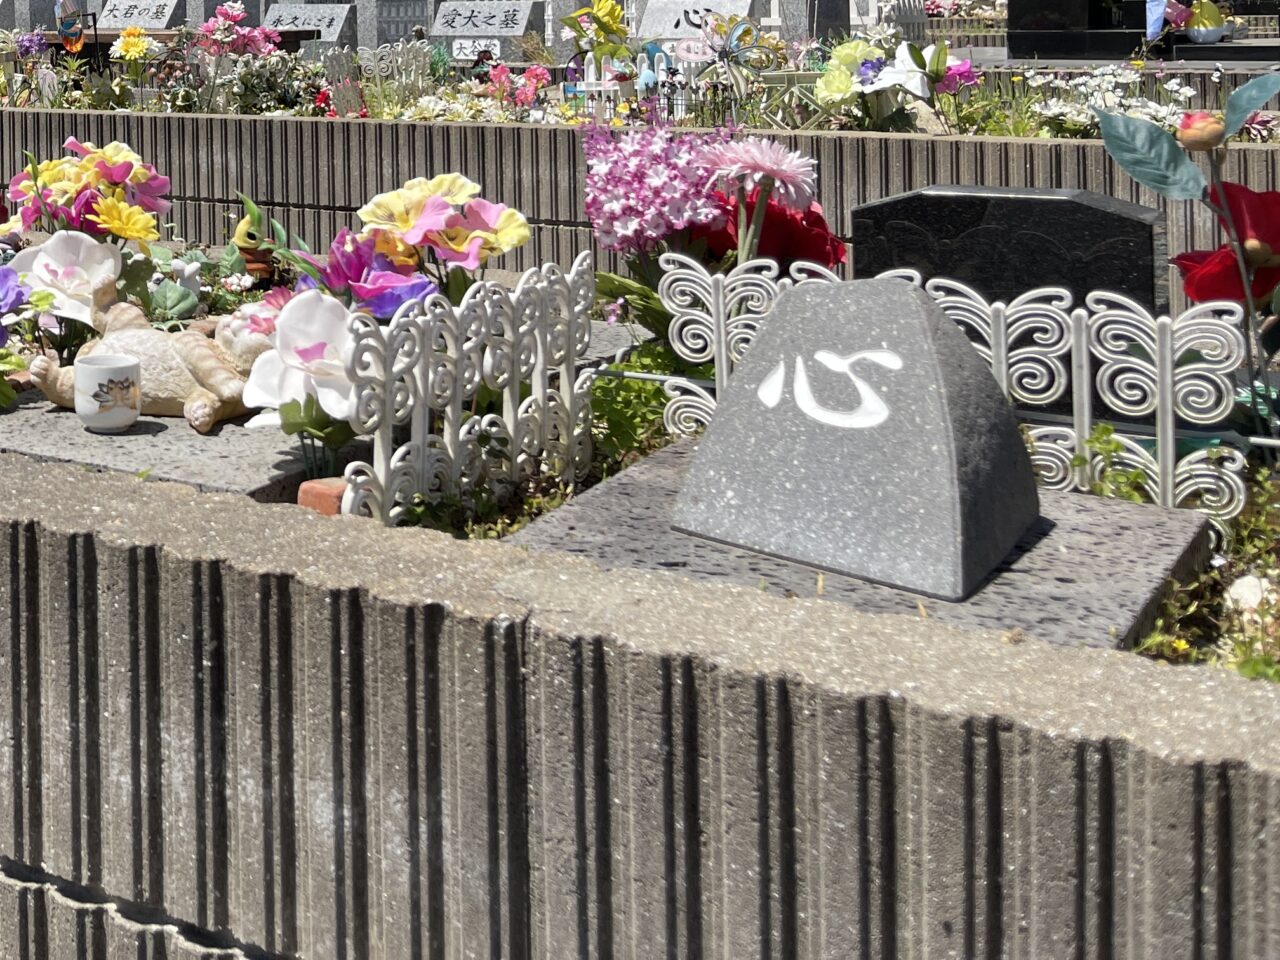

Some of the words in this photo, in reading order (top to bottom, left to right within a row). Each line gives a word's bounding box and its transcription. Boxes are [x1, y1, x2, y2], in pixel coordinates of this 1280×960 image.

[441, 8, 521, 29] 愛犬之墓
[757, 350, 903, 429] 心
